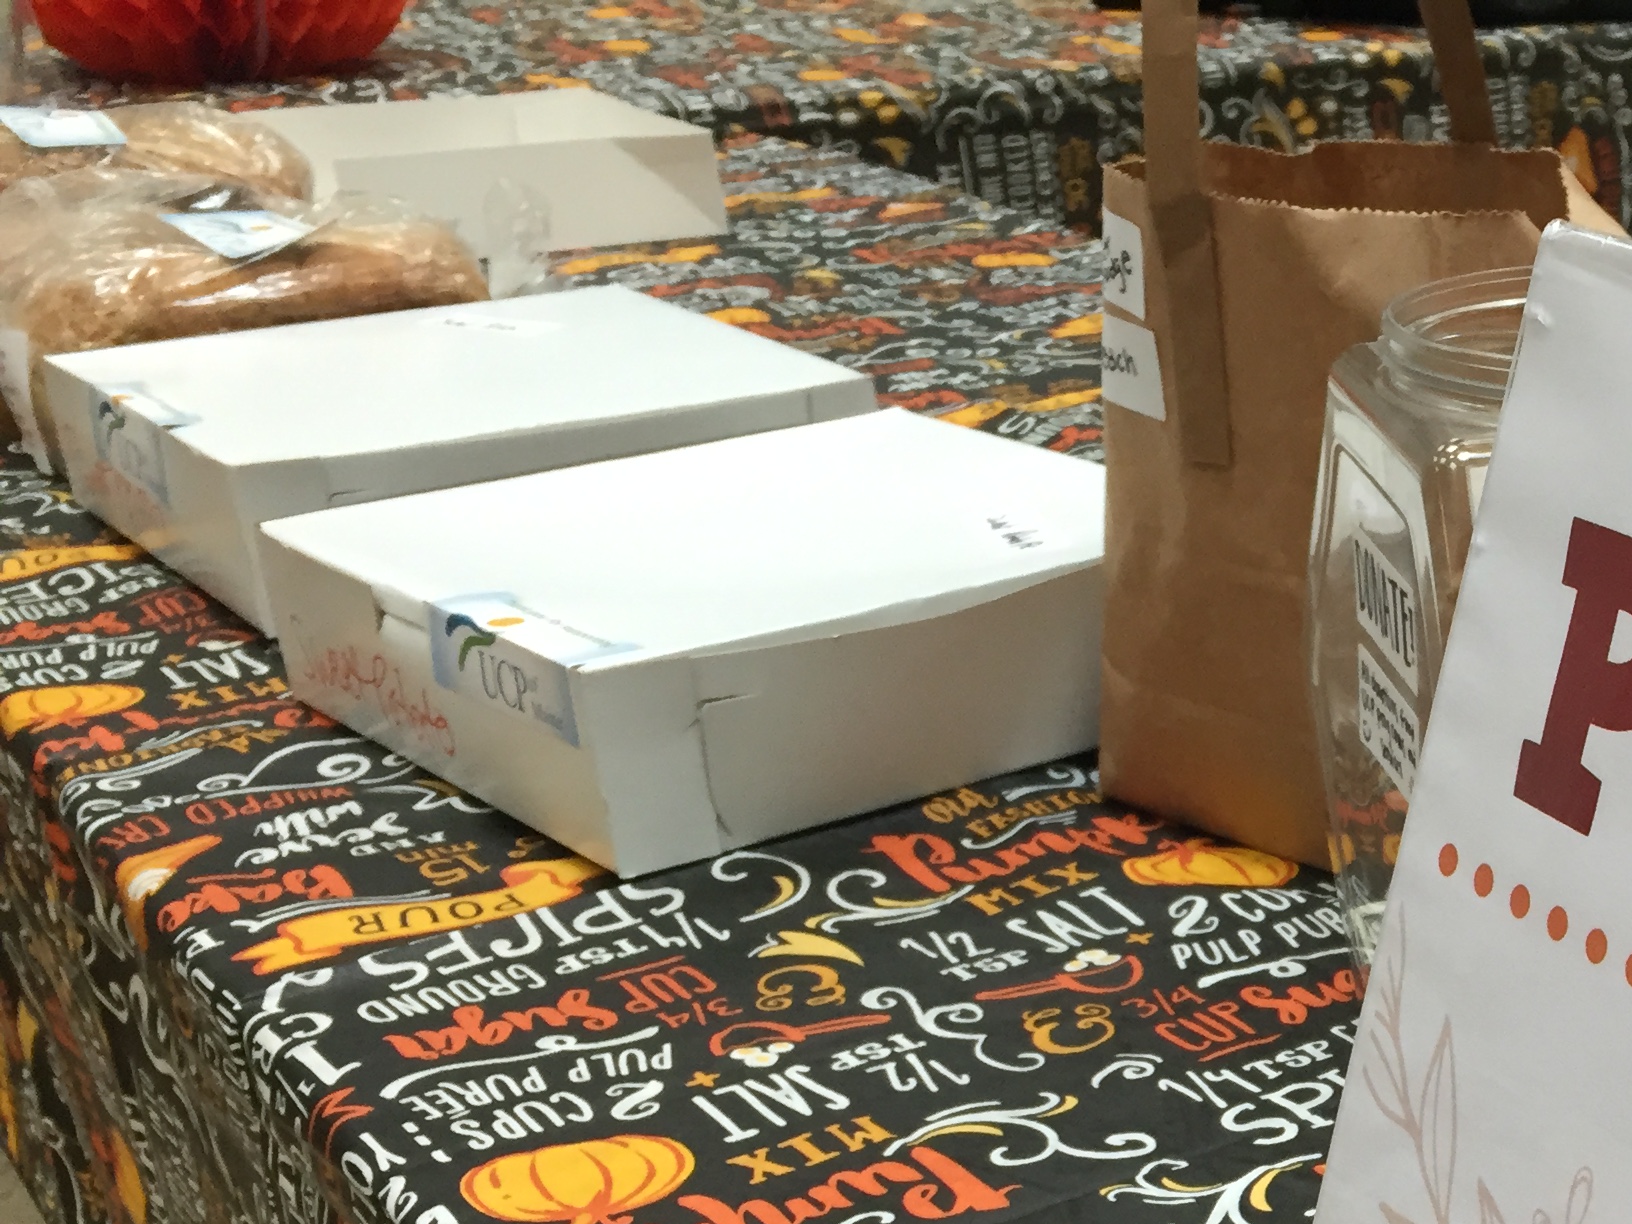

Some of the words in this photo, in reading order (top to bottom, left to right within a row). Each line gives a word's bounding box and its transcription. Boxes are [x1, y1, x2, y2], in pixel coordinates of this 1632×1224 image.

[159, 648, 271, 690] SALT
[477, 650, 528, 713] UCP
[349, 891, 527, 937] POUR
[963, 861, 1100, 917] MIX
[357, 881, 686, 992] SPICES
[1005, 885, 1146, 954] SALT
[554, 924, 648, 973] TSP
[939, 949, 1030, 983] TSP
[1170, 929, 1263, 970] PULP
[356, 962, 547, 1024] GROUND
[622, 963, 720, 1015] CUP
[1154, 1000, 1257, 1052] CUP
[567, 1040, 674, 1085] PULP
[829, 1031, 931, 1074] TSP
[1242, 1039, 1334, 1081] TSP
[450, 1089, 596, 1152] CUPS
[608, 1079, 666, 1122] 2
[688, 1062, 855, 1146] SALT
[726, 1114, 899, 1186] MIX
